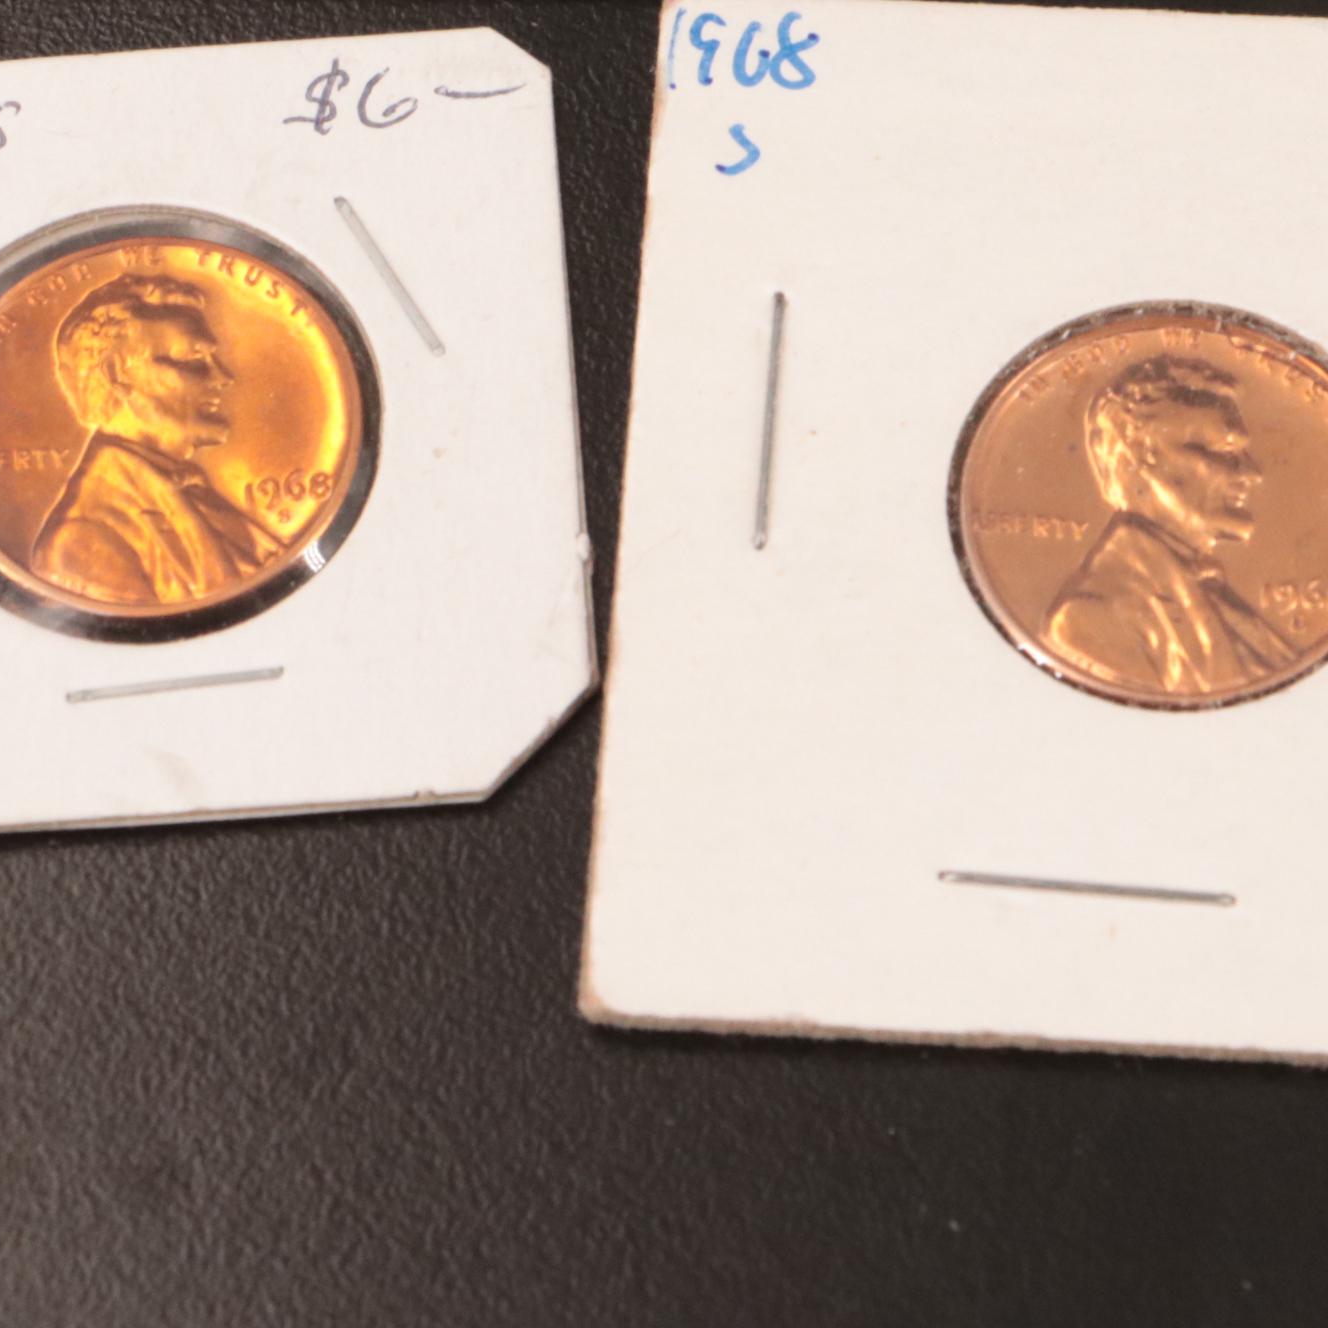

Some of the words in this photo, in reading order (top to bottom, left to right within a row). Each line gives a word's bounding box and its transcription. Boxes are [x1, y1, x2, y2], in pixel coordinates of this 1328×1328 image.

[669, 9, 820, 90] 1968
[197, 249, 309, 318] TRUST
[244, 473, 332, 514] 1968
